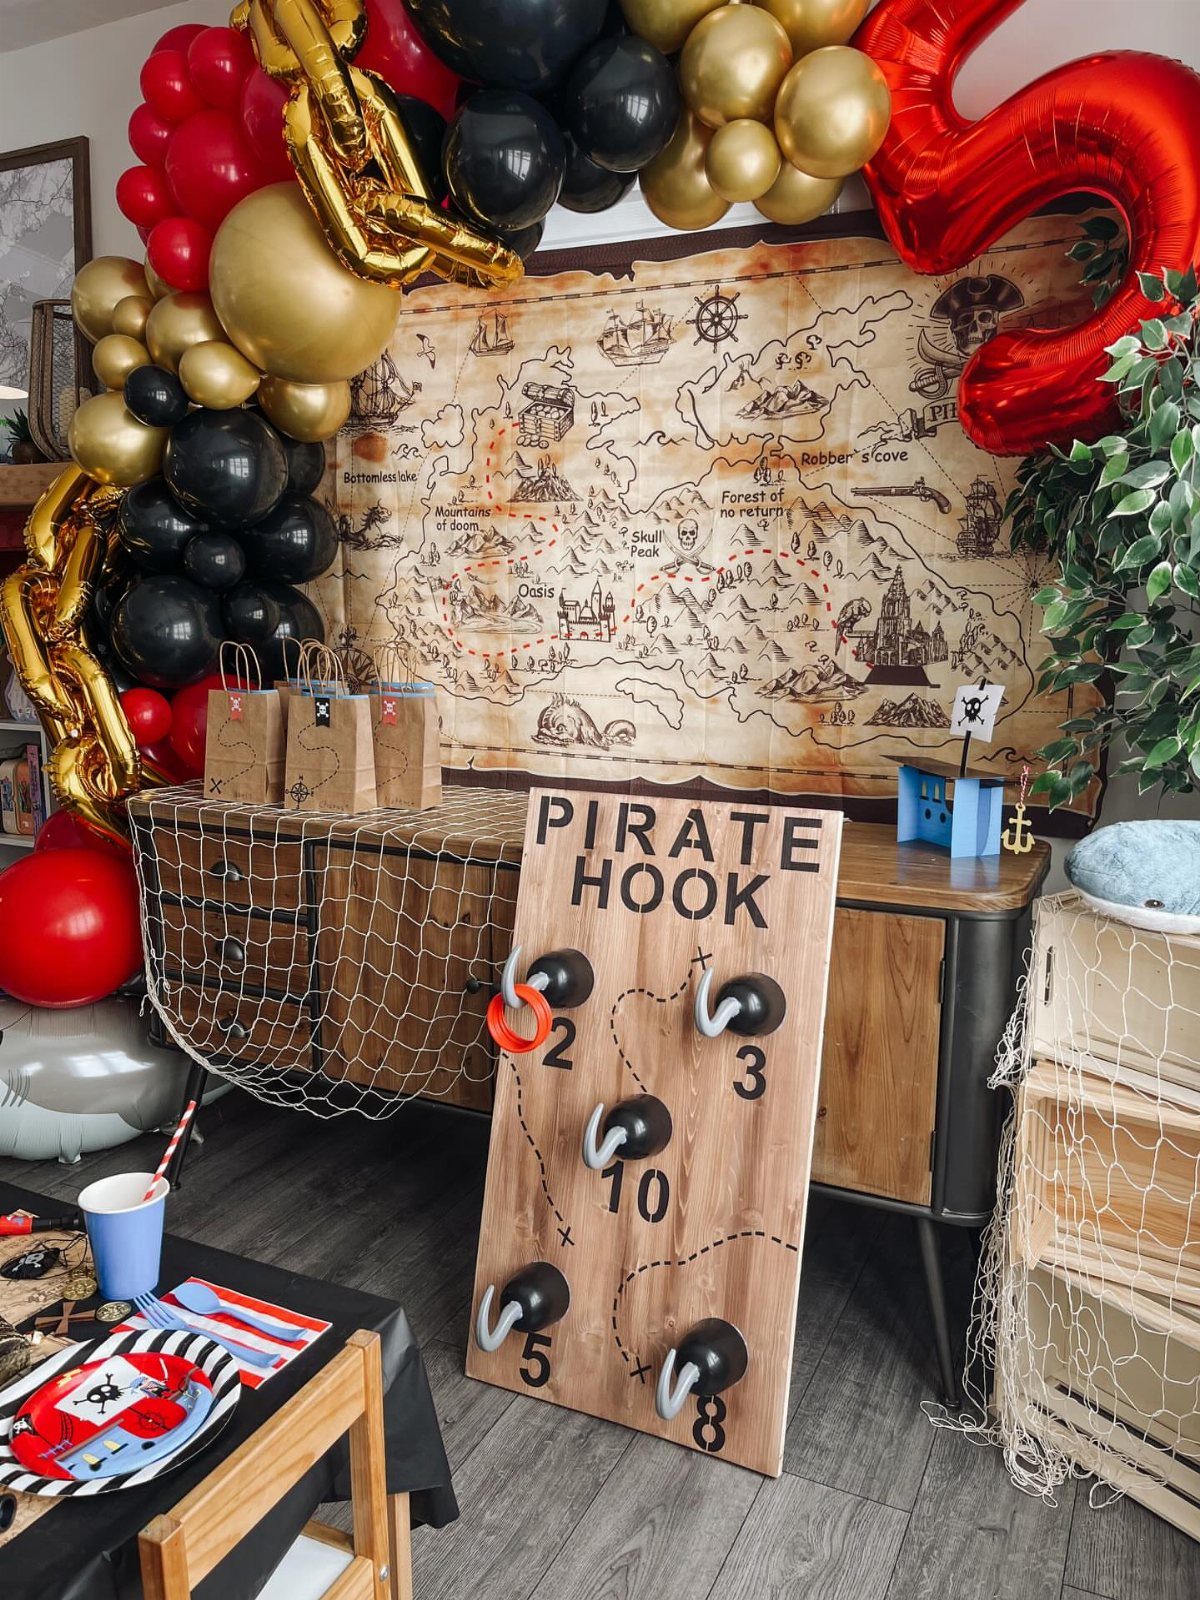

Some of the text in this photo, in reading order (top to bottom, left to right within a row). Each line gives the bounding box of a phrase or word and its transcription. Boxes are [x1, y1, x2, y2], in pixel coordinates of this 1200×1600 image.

[874, 451, 909, 463] cove
[343, 469, 418, 484] Bottomless lake
[721, 488, 785, 504] Forest of
[435, 506, 492, 518] Mountains
[720, 506, 784, 518] no return
[436, 519, 480, 531] of doom
[631, 530, 662, 543] Skull
[631, 545, 660, 558] Peak
[518, 583, 555, 598] Oasis
[536, 795, 823, 873] PIRATE
[571, 856, 771, 929] HOOK
[542, 1016, 577, 1070] 2
[732, 1045, 767, 1101] 3
[600, 1160, 670, 1224] 10
[518, 1332, 552, 1388] 5
[691, 1395, 727, 1453] 8
